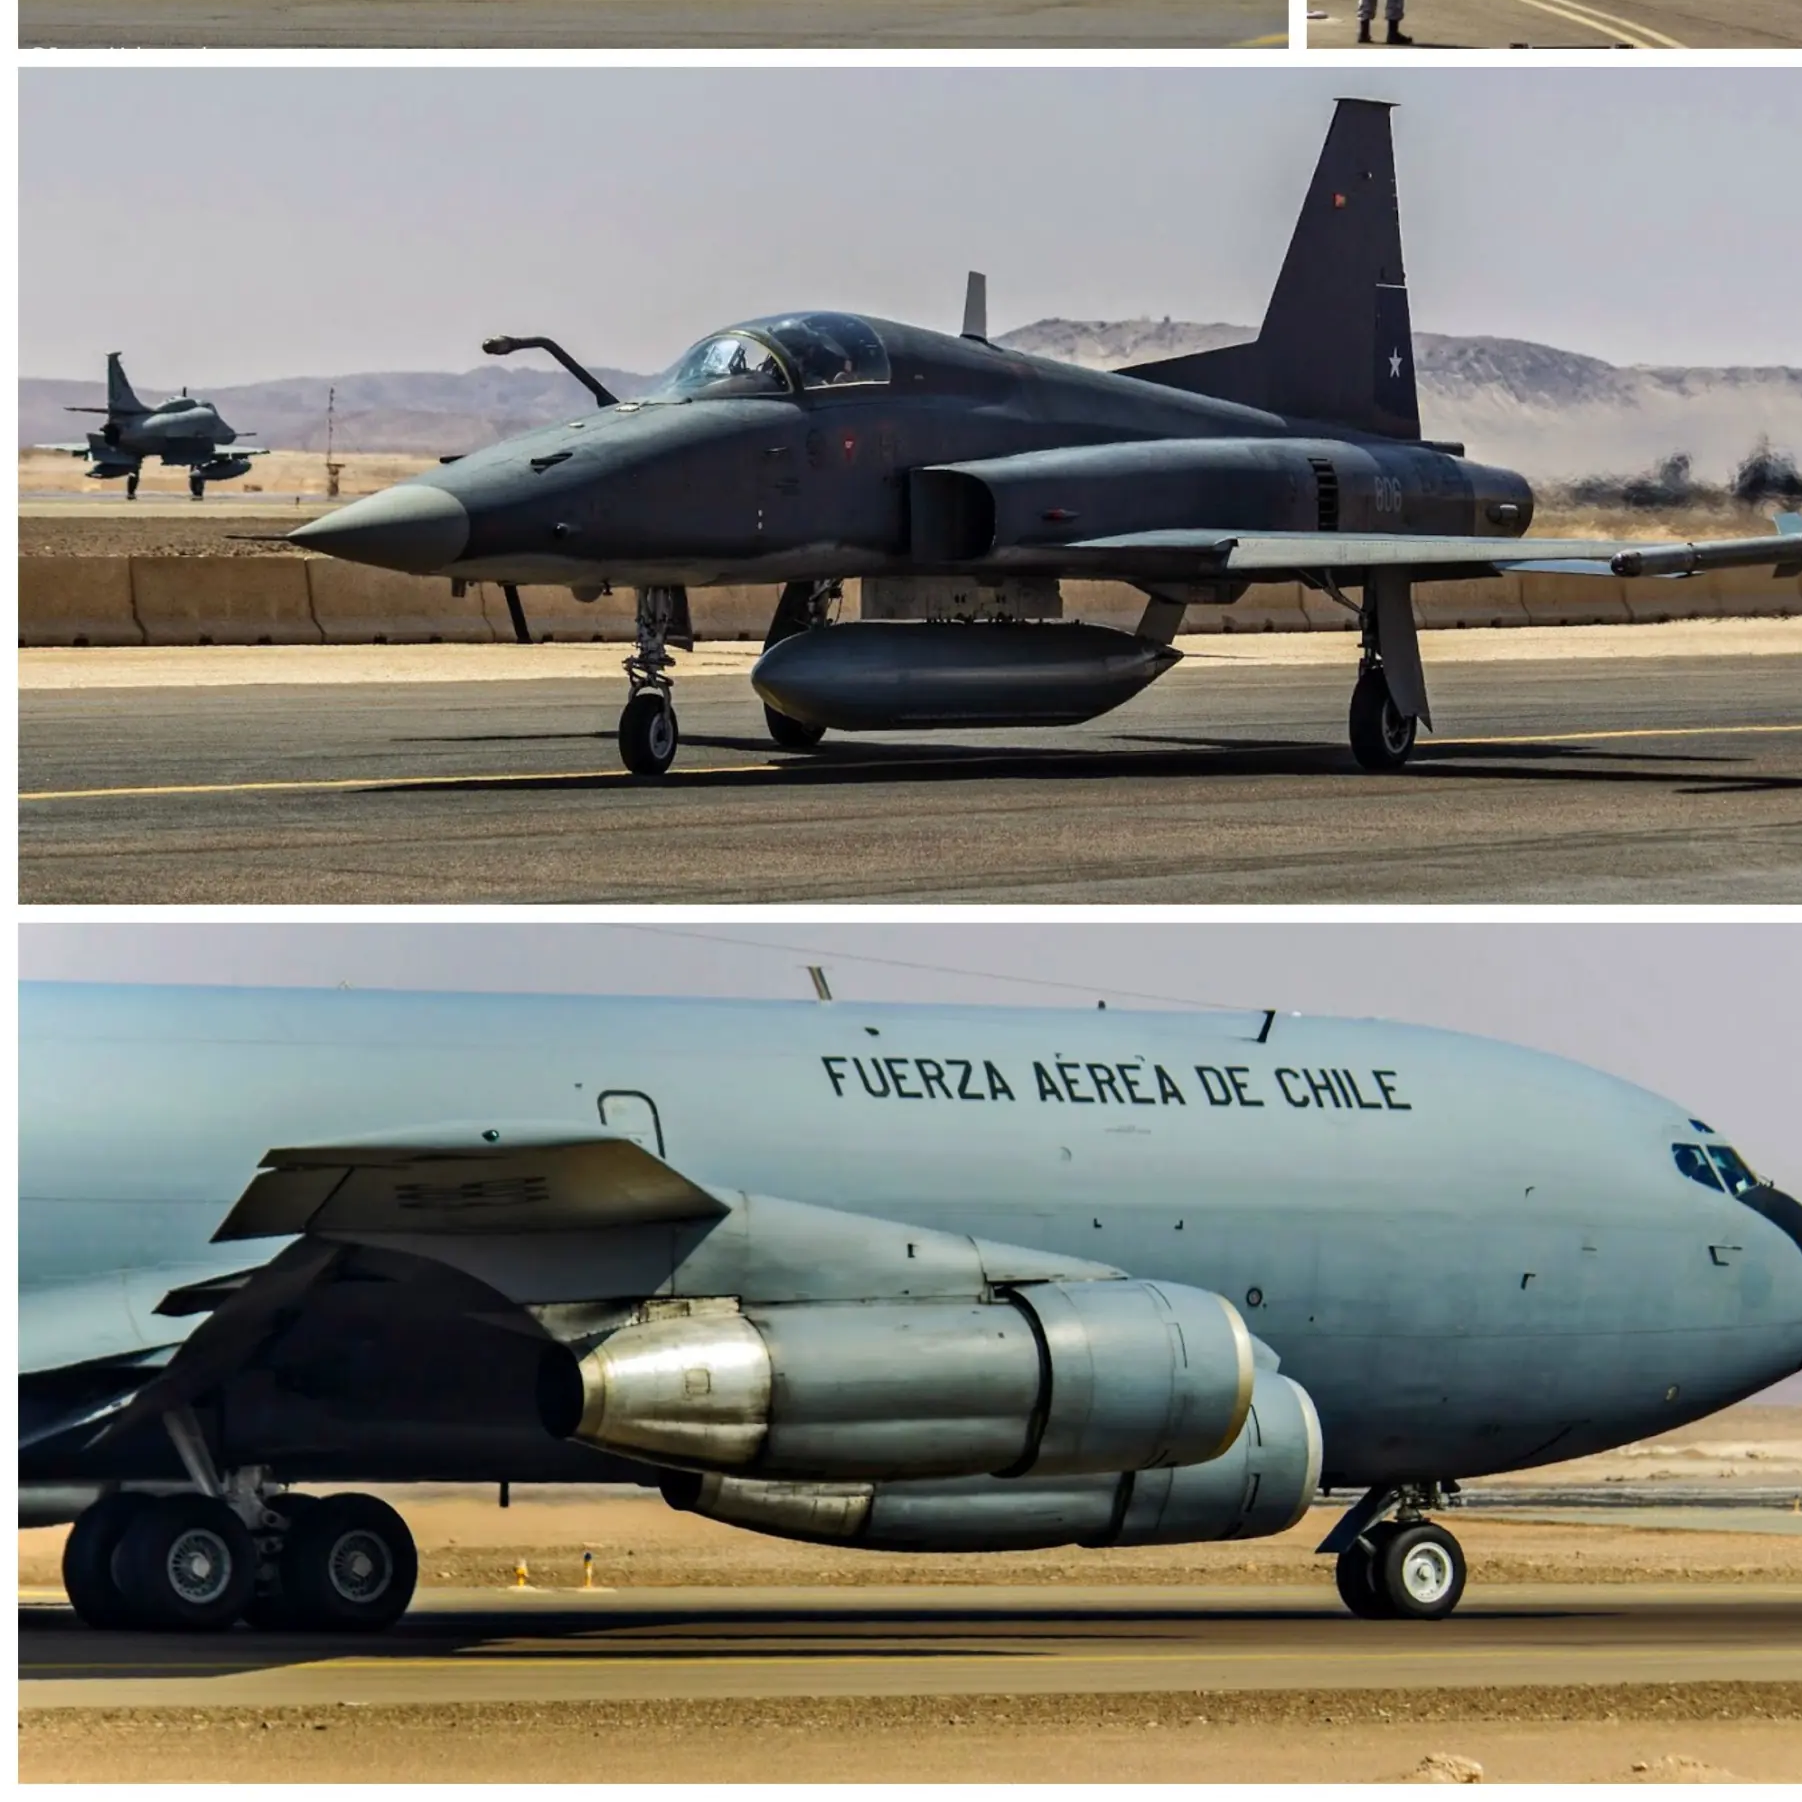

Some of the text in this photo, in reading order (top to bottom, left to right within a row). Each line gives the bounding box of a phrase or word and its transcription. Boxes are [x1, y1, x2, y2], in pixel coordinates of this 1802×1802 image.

[1375, 476, 1402, 513] 806
[821, 1056, 1015, 1101] FUERZA
[1194, 1065, 1264, 1107] DE
[1274, 1068, 1412, 1110] CHILE
